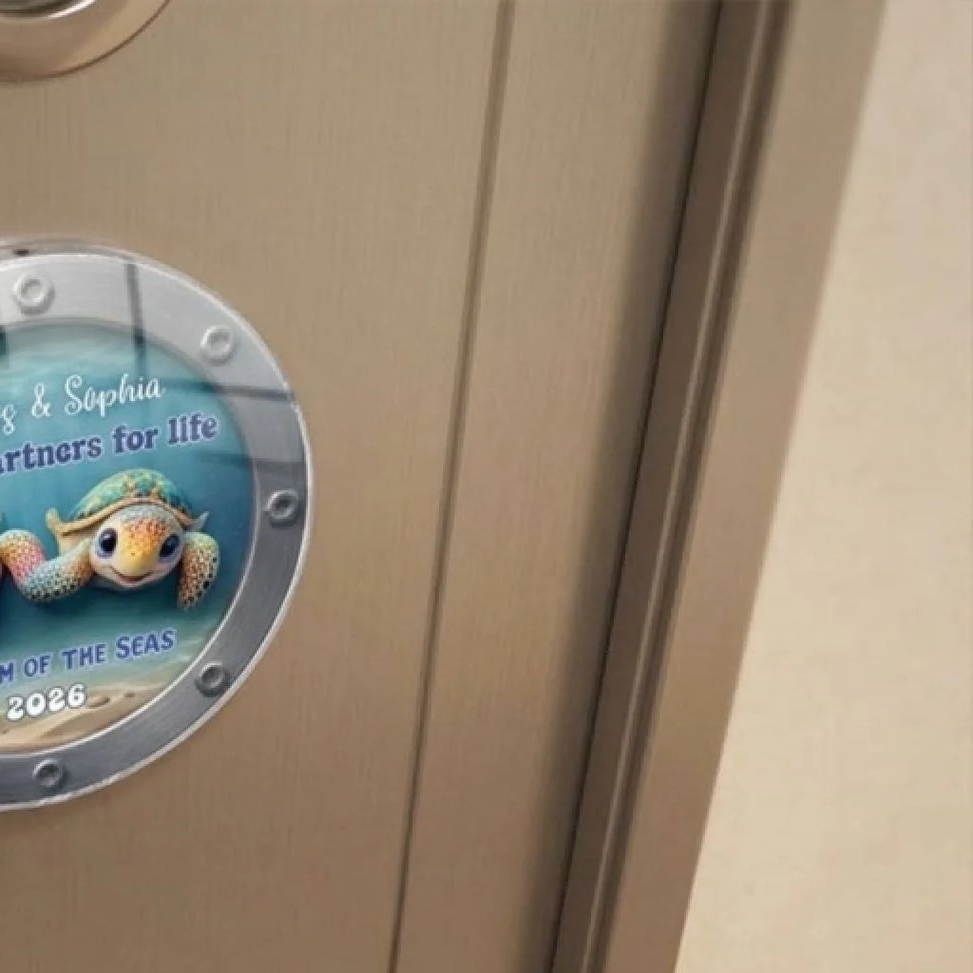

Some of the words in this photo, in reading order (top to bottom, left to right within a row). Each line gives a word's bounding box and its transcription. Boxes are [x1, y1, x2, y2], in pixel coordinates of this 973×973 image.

[30, 381, 52, 418] &
[64, 373, 166, 418] Sophia
[112, 425, 159, 455] for
[167, 412, 218, 446] life
[23, 655, 52, 679] OF
[62, 643, 107, 671] THE
[114, 628, 176, 661] SEAS
[5, 683, 87, 721] 2026
